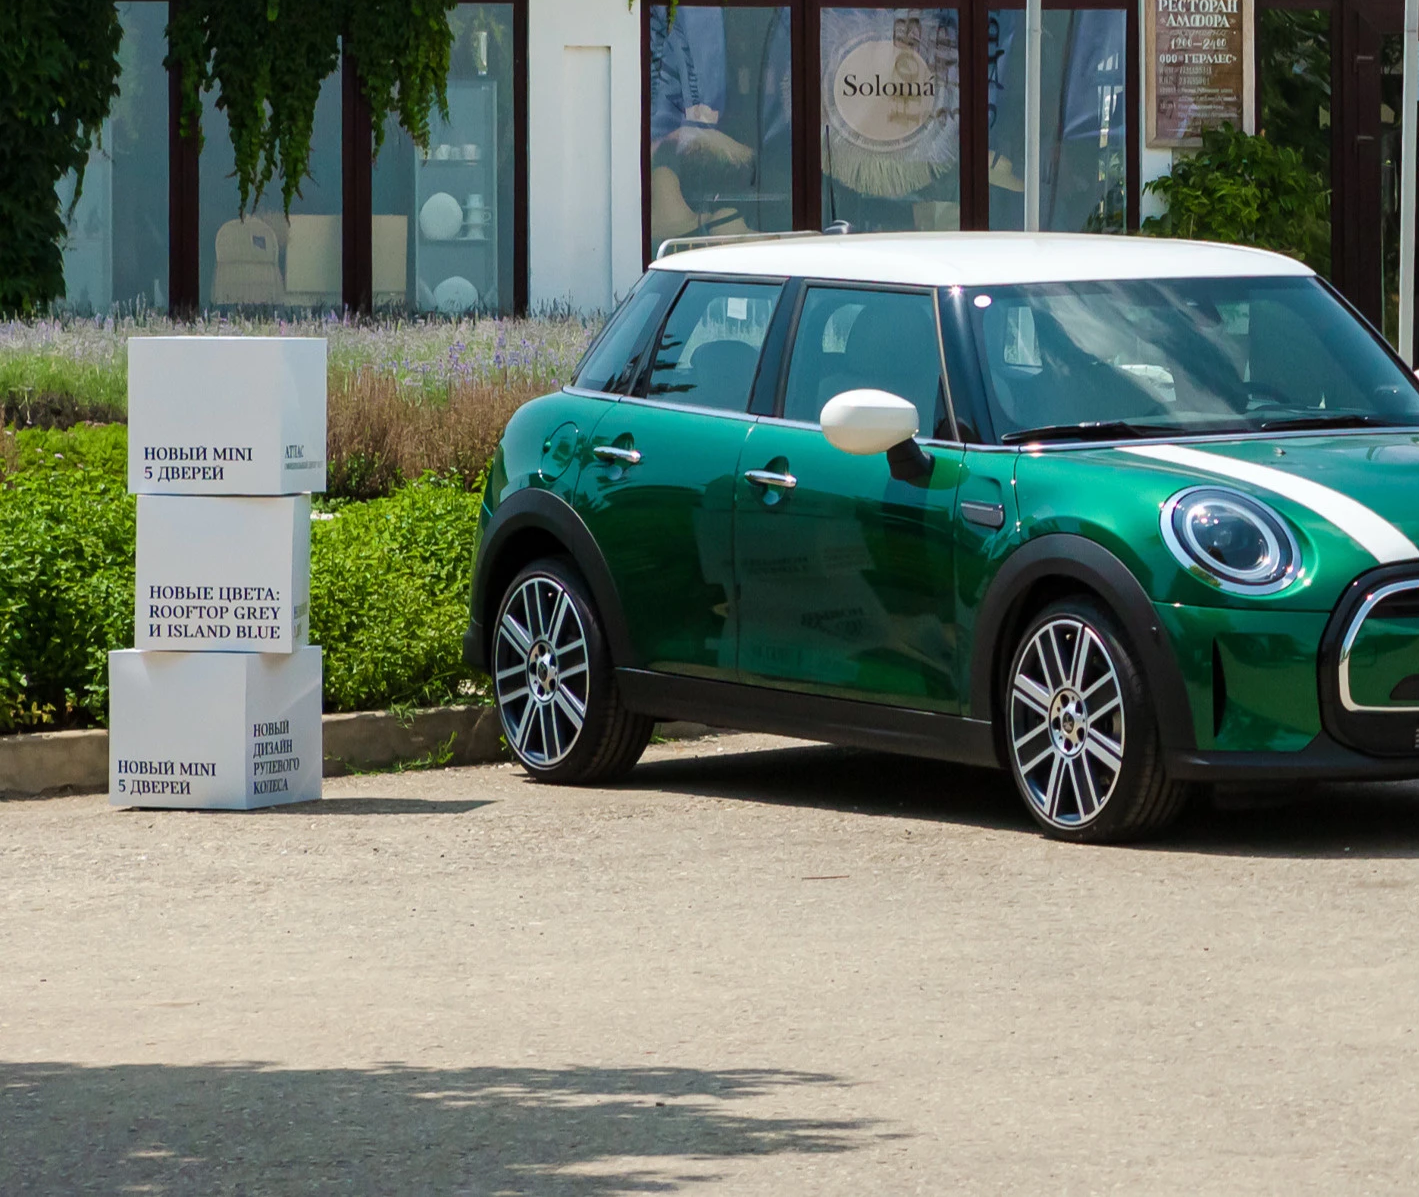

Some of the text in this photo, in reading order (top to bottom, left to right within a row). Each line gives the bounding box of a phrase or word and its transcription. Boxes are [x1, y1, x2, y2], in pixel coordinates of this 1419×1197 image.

[842, 74, 935, 97] Solomá
[144, 445, 253, 461] НОВЫЙ MINI
[144, 465, 224, 482] 5 ДВЕРЕЙ
[149, 585, 280, 603] НОВЫЕ ЦВЕТА:
[149, 605, 281, 620] ROOFTOP GREY
[149, 624, 280, 639] И ISLAND BLUE
[253, 719, 289, 737] НОВЫЙ
[253, 738, 293, 759] ДИЗАЙН
[118, 760, 216, 776] НОВЫЙ MINI
[253, 757, 300, 776] РУЛЕВОГО
[118, 779, 191, 795] 5 ДВЕРЕЙ
[253, 778, 289, 795] КОЛЕСА
